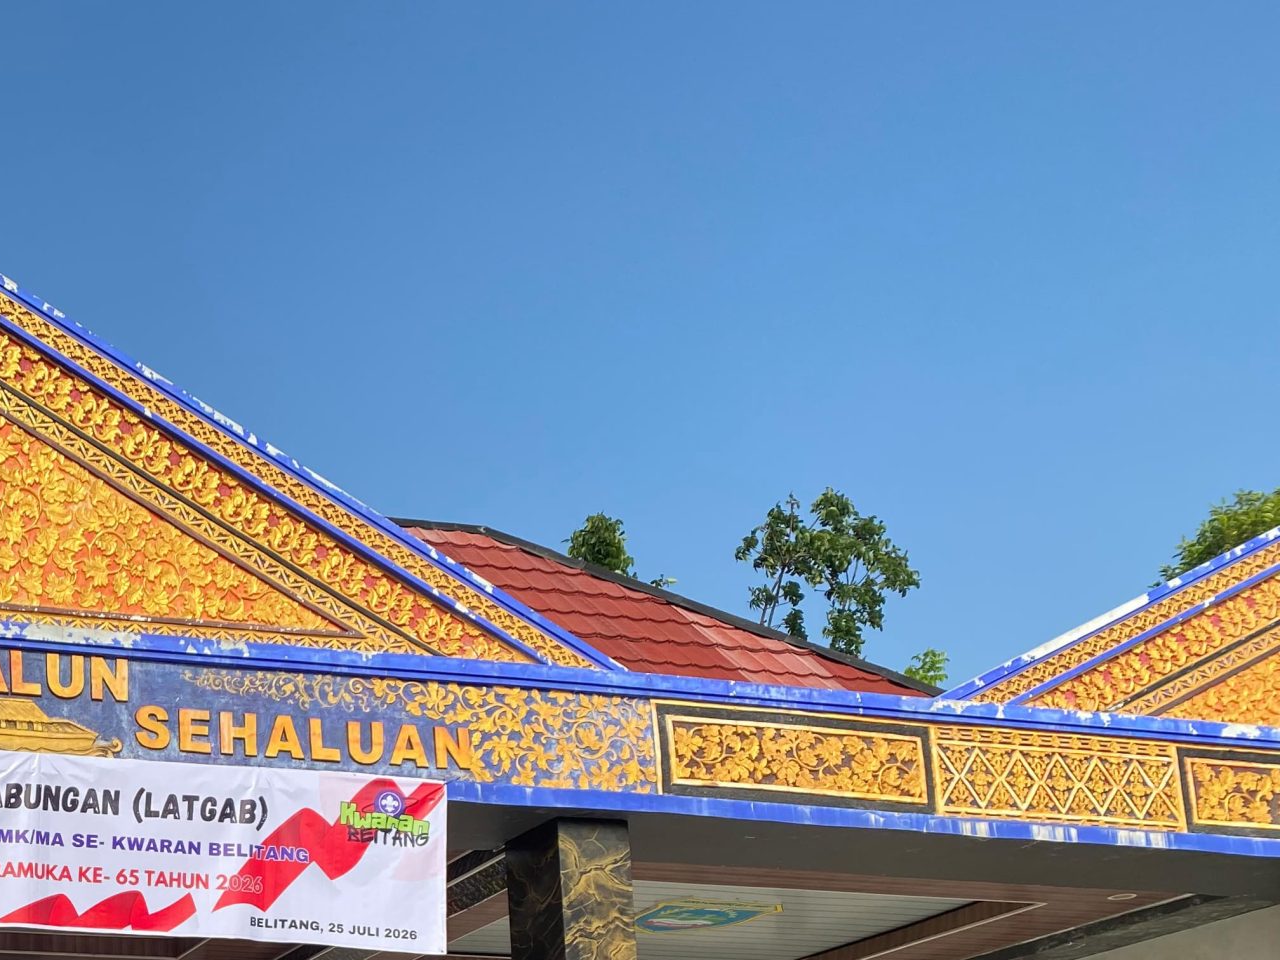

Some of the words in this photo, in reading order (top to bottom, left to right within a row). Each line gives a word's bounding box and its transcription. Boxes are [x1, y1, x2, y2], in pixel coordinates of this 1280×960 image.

[134, 704, 471, 770] SEHALUAN
[132, 787, 269, 831] (LATGAB)
[340, 801, 430, 836] Kwaran
[72, 833, 105, 849] SE-
[112, 836, 202, 856] KWARAN
[208, 841, 310, 863] BELITANG
[78, 866, 111, 884] KE-
[115, 868, 140, 886] 65
[145, 870, 210, 890] TAHUN
[215, 873, 264, 894] 2026
[250, 916, 324, 934] BELITANG,
[328, 922, 345, 934] 25
[348, 925, 380, 937] JULI
[384, 928, 419, 940] 2026
